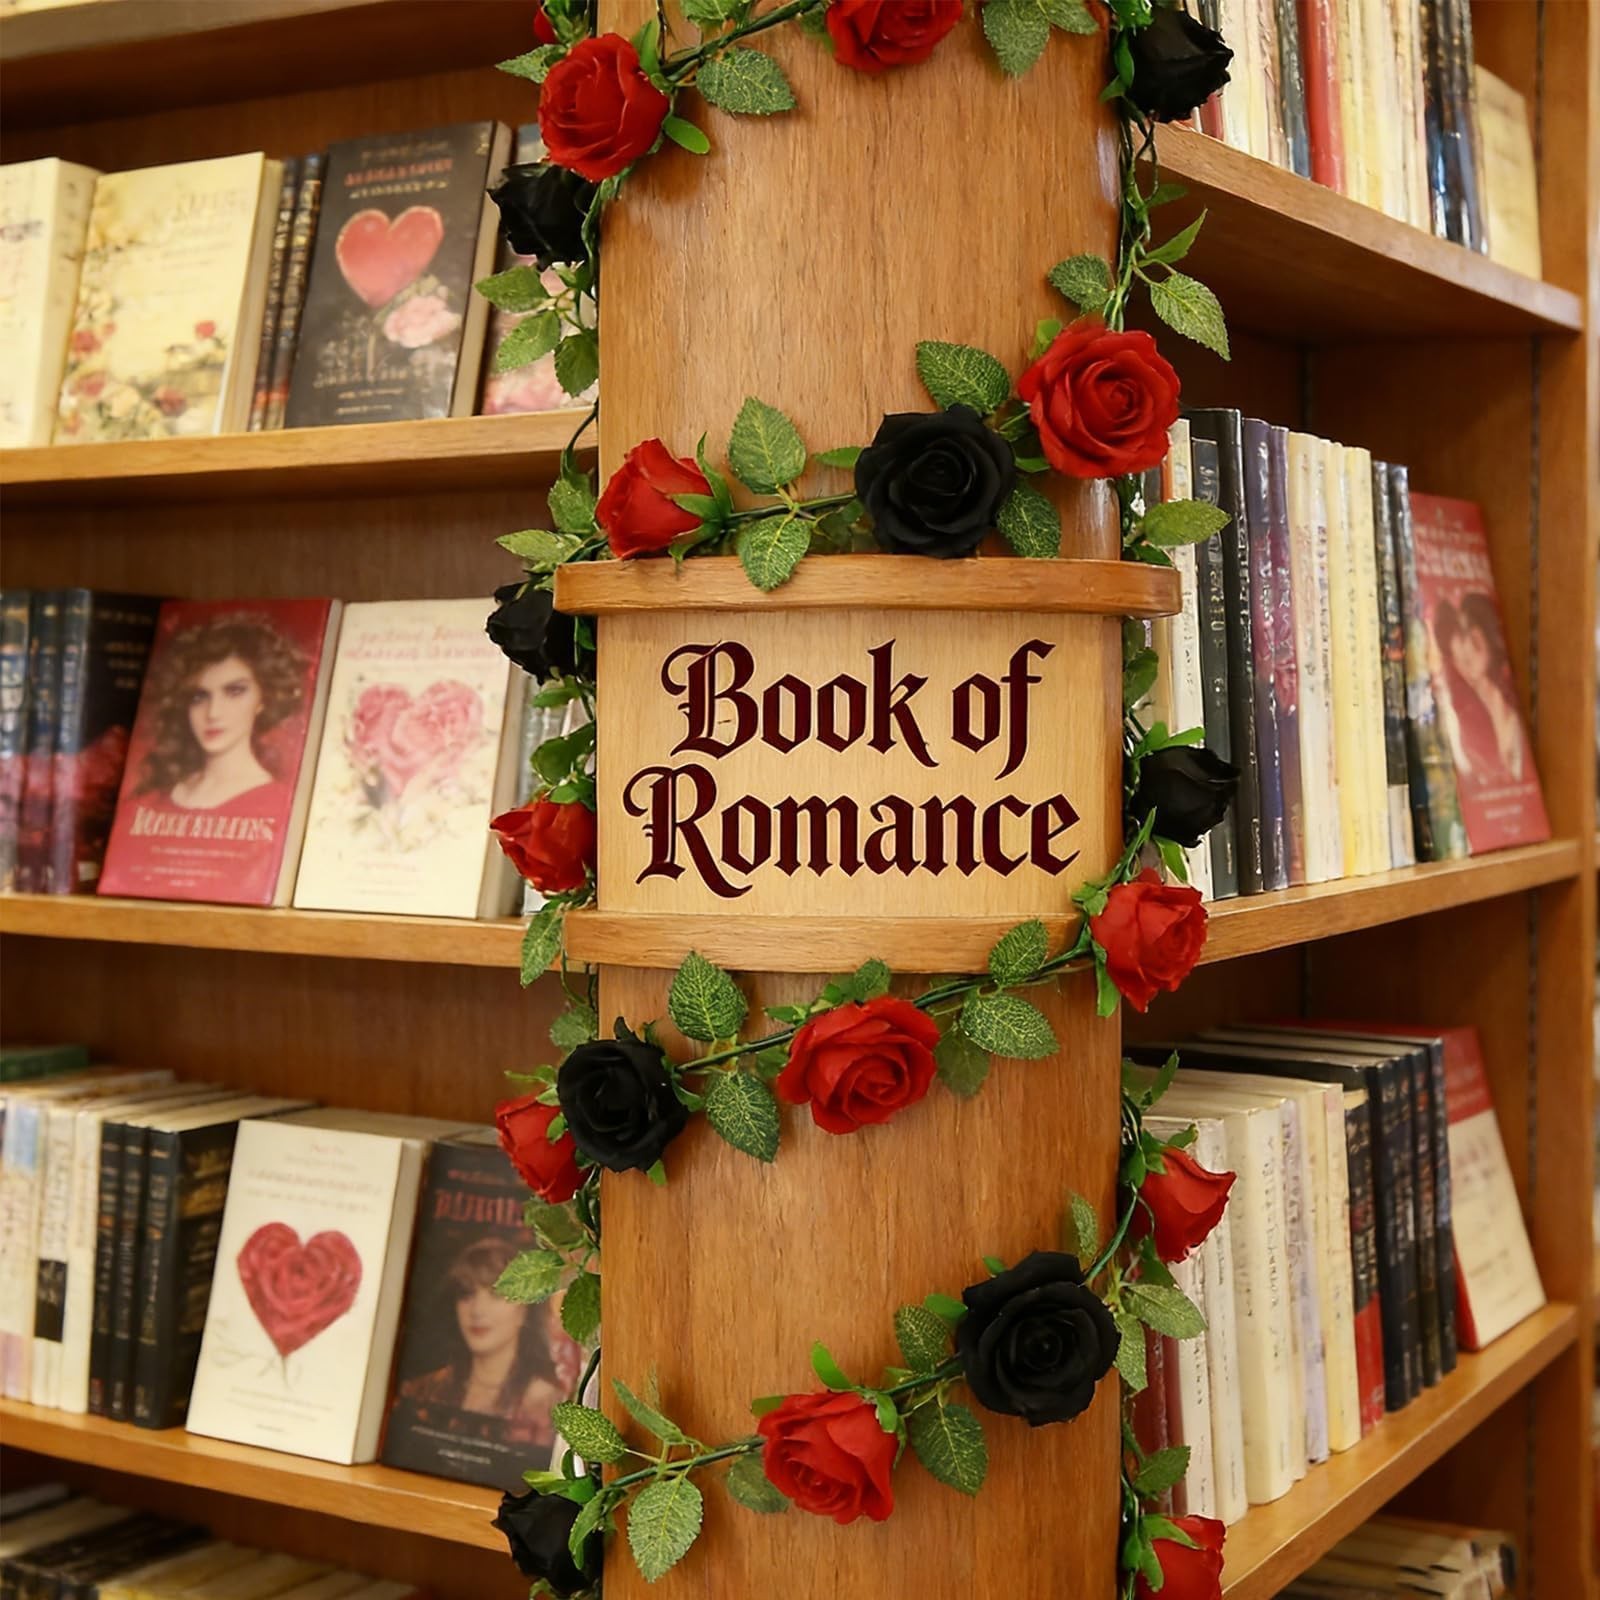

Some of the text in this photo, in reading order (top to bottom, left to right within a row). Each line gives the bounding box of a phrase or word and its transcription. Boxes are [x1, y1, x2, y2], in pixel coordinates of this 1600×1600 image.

[661, 638, 1056, 781] Book of
[623, 763, 1081, 899] Romance
